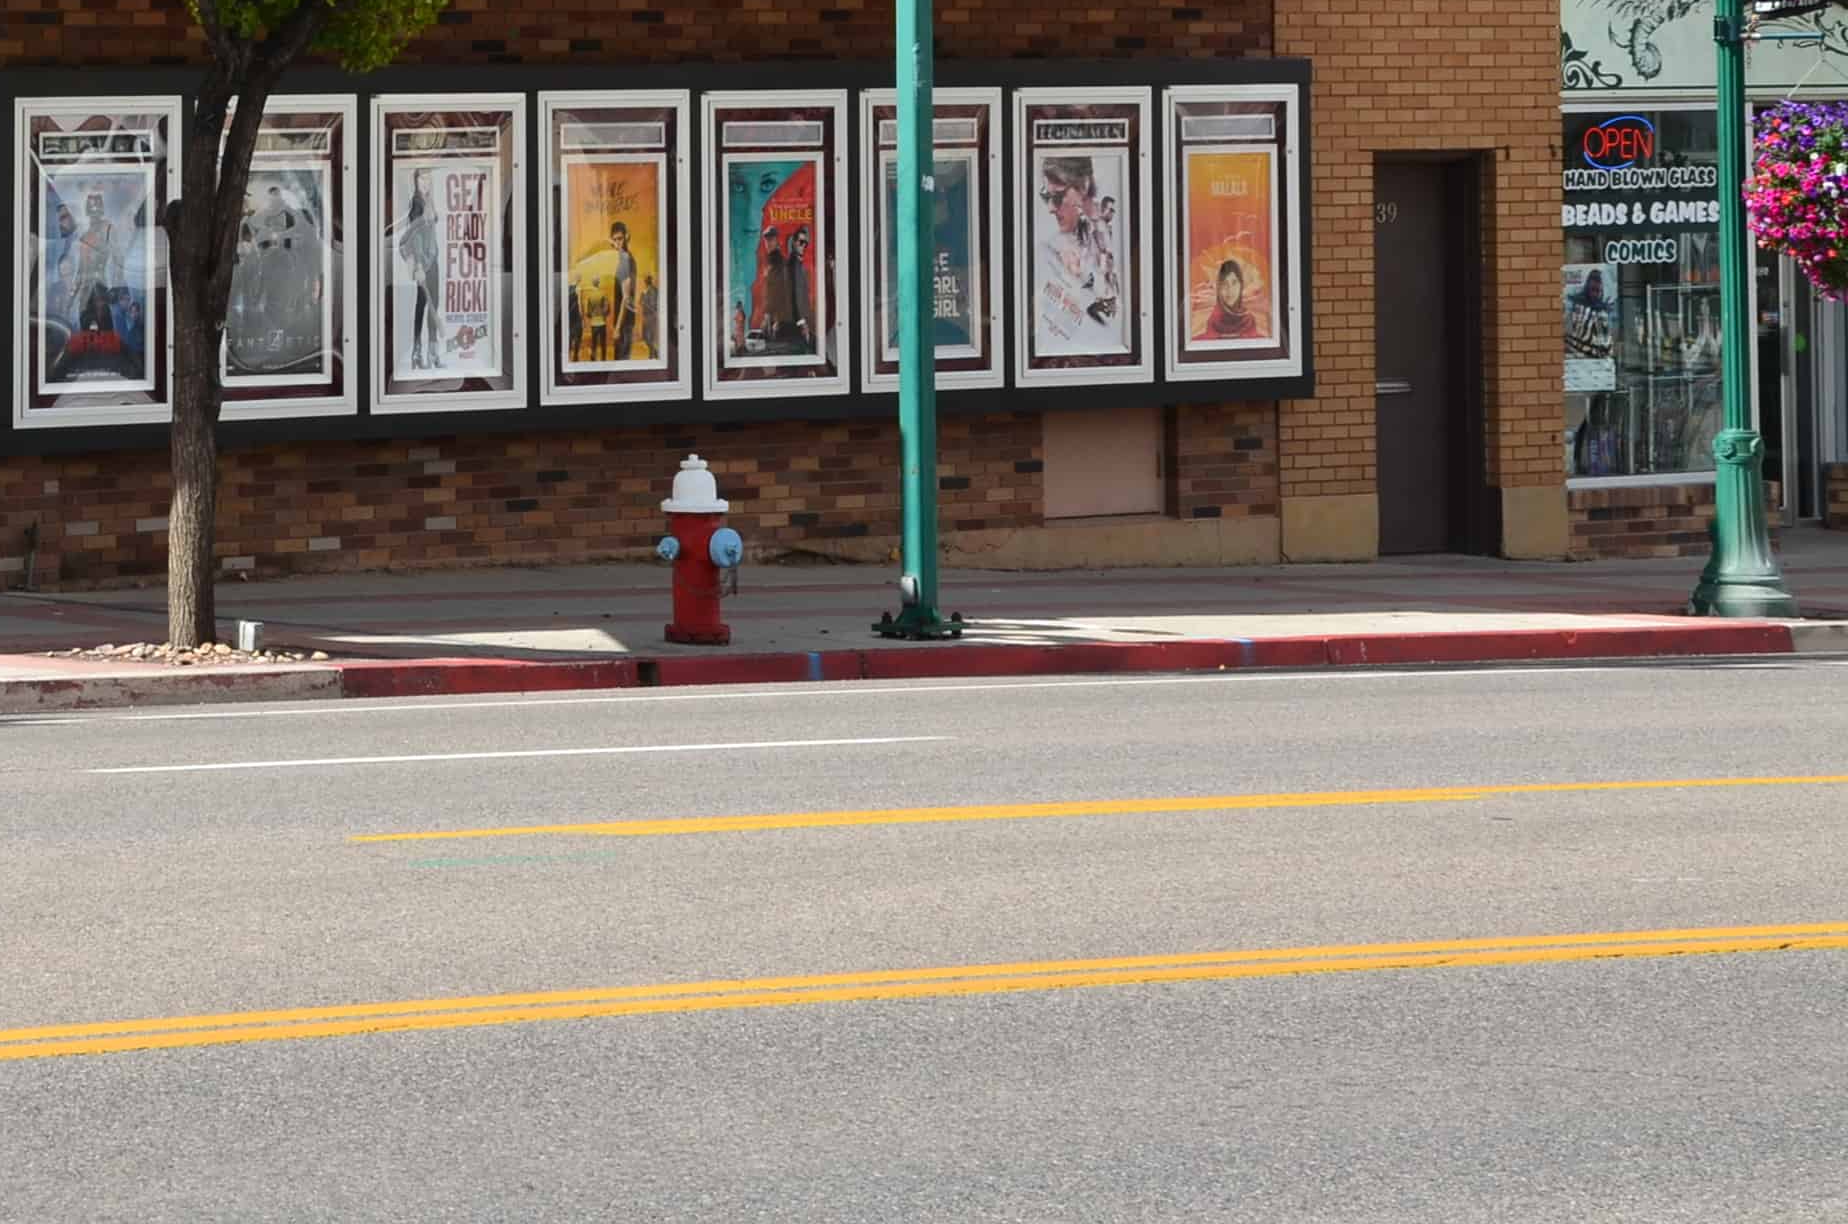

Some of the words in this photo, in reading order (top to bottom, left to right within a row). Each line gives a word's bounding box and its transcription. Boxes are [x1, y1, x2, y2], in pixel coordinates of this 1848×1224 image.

[1584, 127, 1654, 159] OPEN
[1563, 169, 1609, 190] HAND
[1610, 168, 1667, 189] BLOWN
[1668, 166, 1716, 187] GLASS
[446, 173, 487, 212] GET
[446, 213, 487, 241] READY
[1375, 202, 1398, 224] 39
[1562, 203, 1628, 226] BEADS
[1632, 202, 1646, 224] &
[1650, 200, 1720, 223] GAMES
[446, 242, 487, 279] FOR
[1606, 239, 1677, 264] COMICS
[446, 280, 487, 312] RICKI
